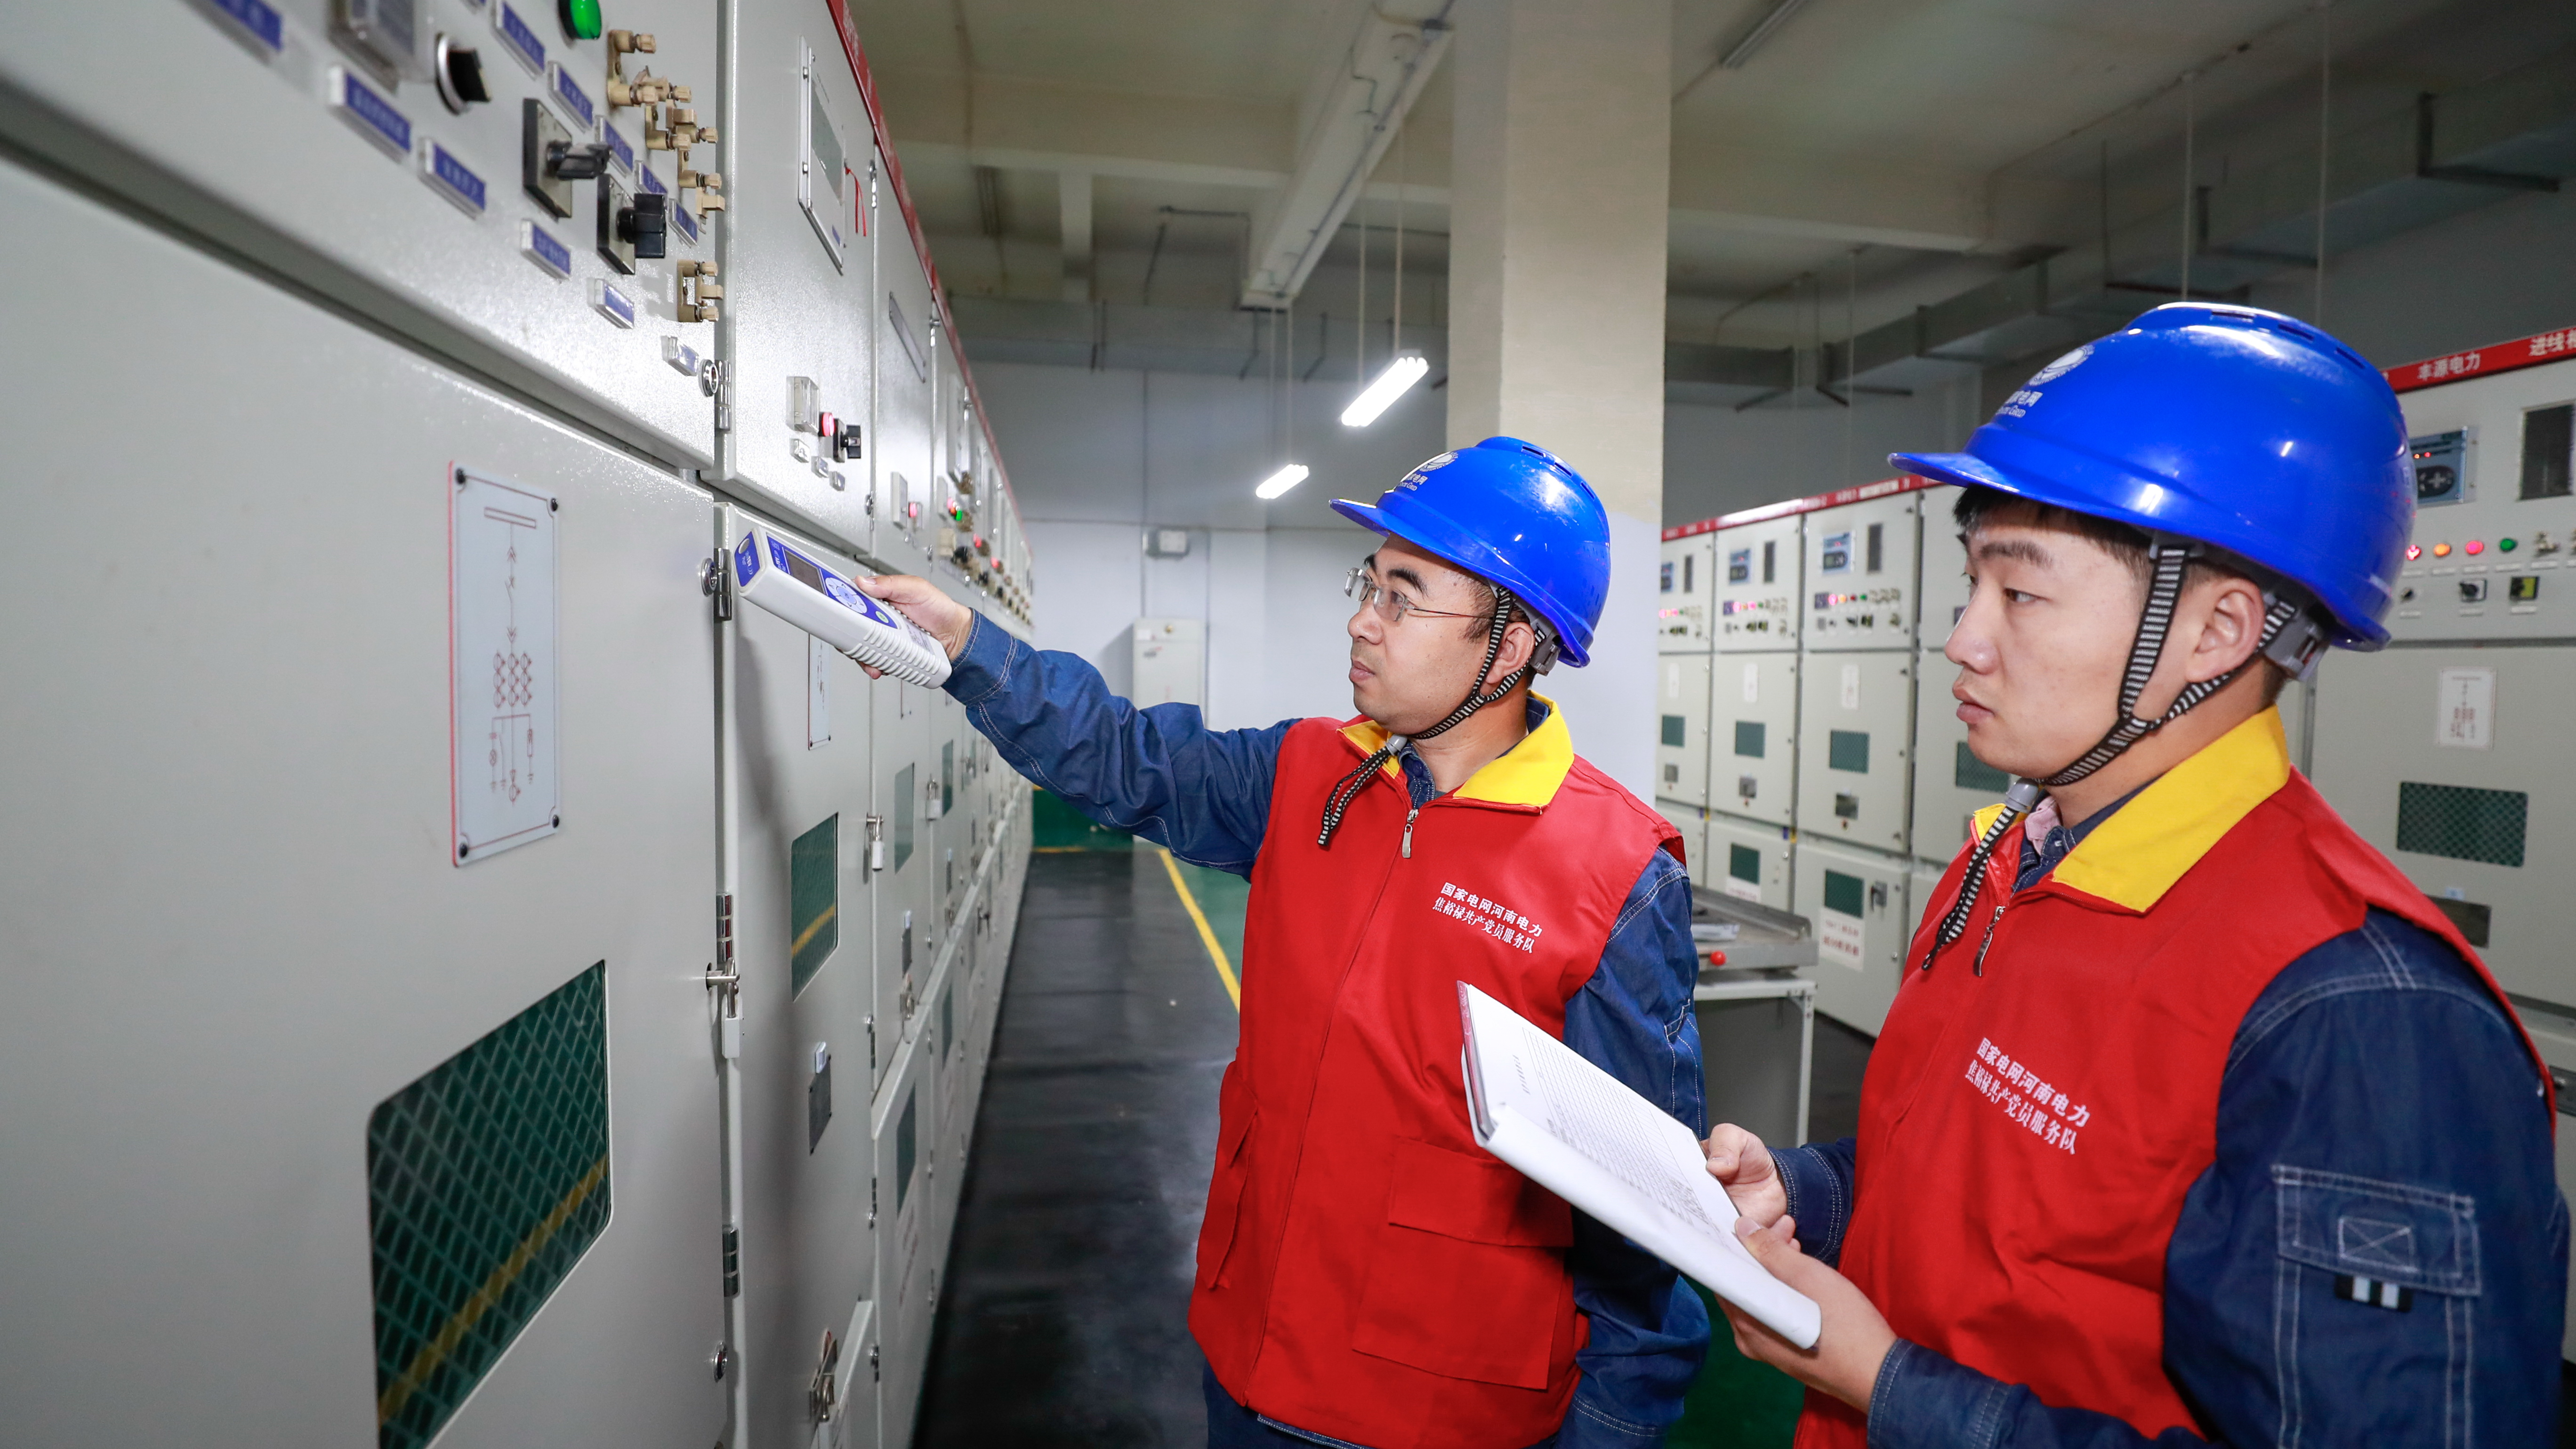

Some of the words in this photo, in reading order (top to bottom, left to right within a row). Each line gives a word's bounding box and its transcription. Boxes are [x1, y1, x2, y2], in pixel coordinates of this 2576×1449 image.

[1433, 897, 1535, 954] 焦裕禄共产党员服务队
[1441, 882, 1543, 937] 国家电网河南电力
[1965, 1060, 2077, 1155] 焦裕禄共产党员服务队
[1976, 1037, 2091, 1128] 国家电网河南电力
